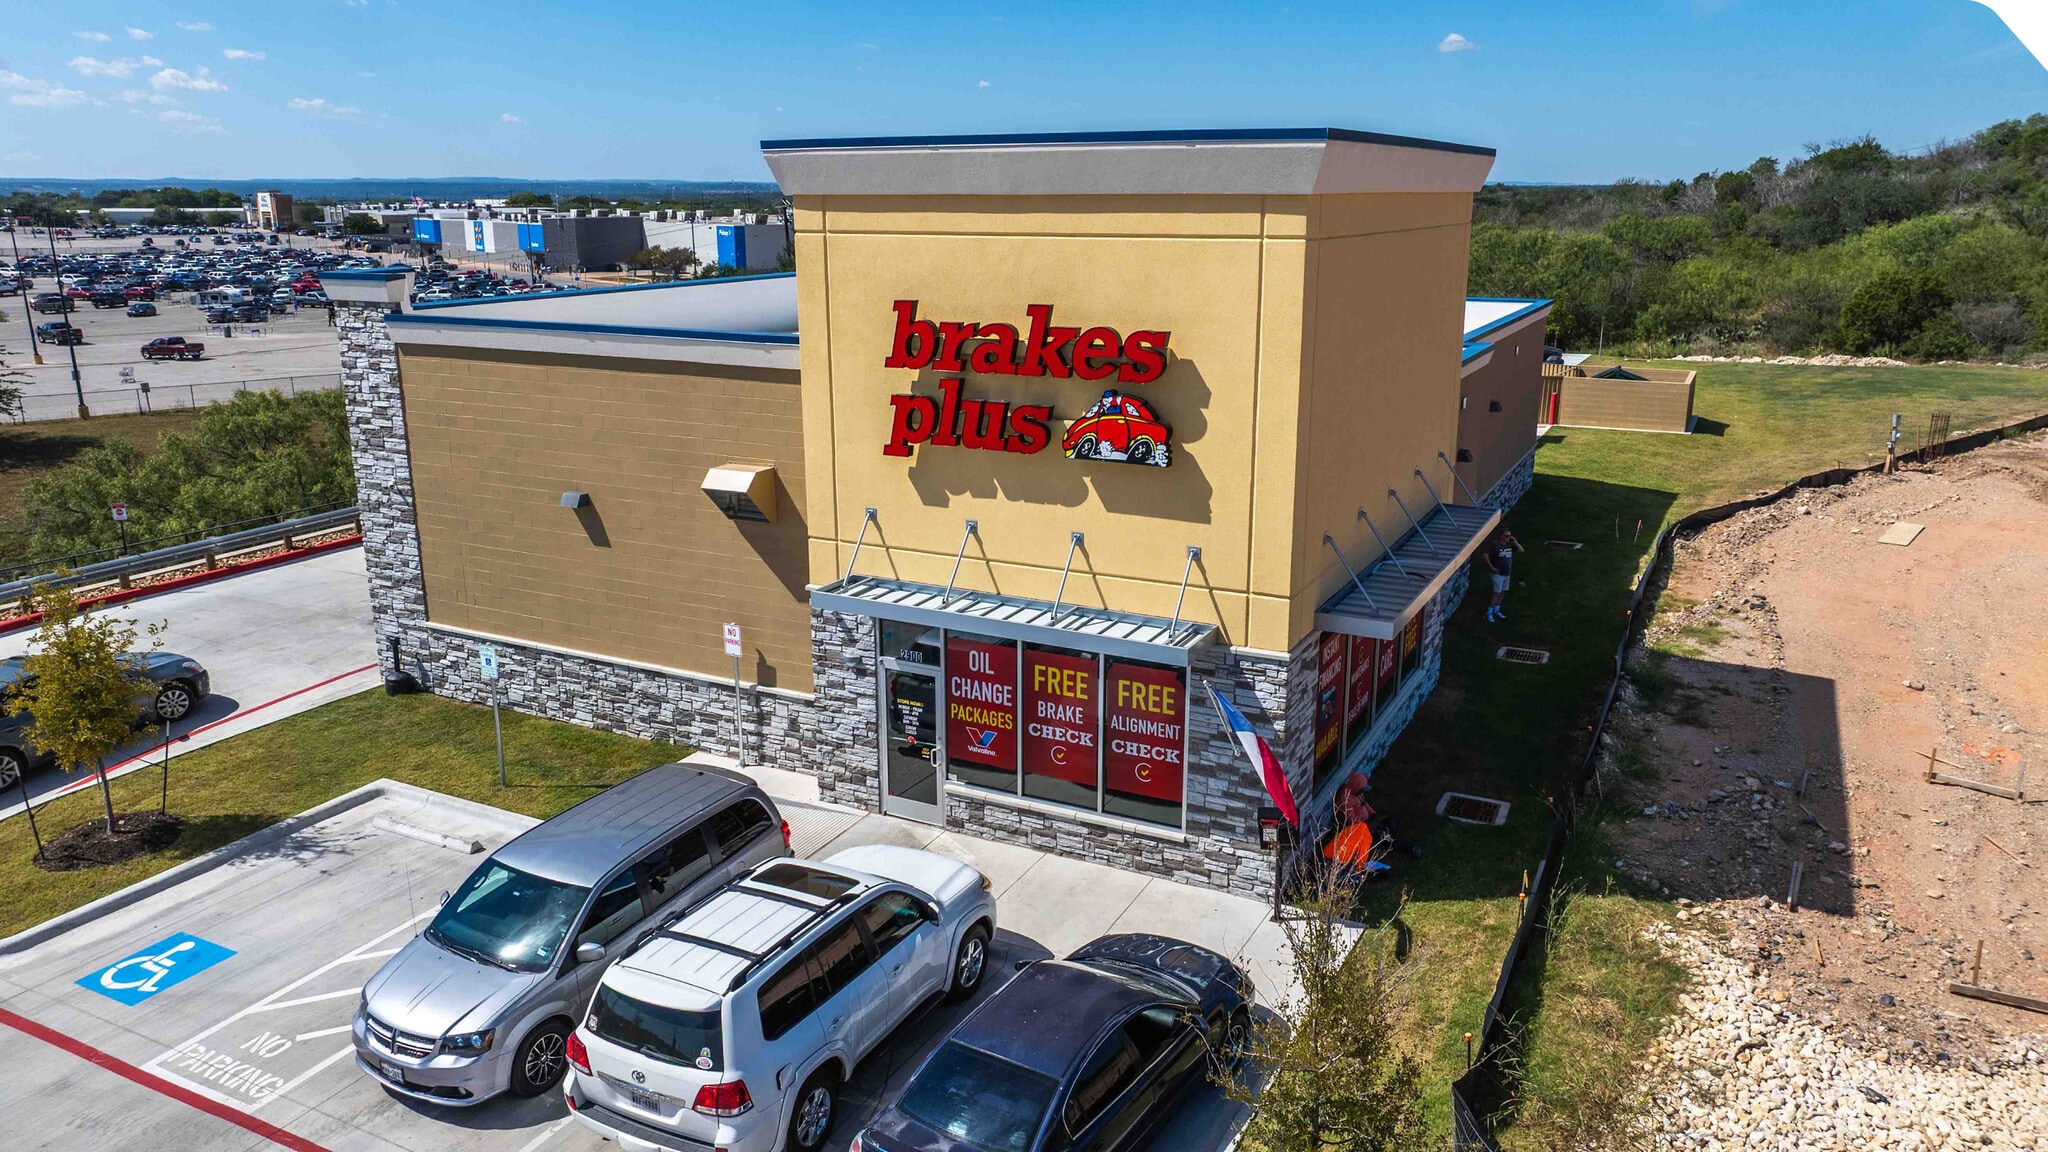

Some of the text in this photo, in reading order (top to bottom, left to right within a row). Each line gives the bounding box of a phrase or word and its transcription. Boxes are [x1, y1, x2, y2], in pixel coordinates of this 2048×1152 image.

[884, 300, 1171, 384] brakes
[883, 377, 1055, 457] plus
[728, 628, 736, 636] NO
[901, 649, 922, 662] 2900
[969, 650, 995, 675] OIL
[951, 676, 1013, 707] CHANGE
[1034, 664, 1089, 700] FREE
[1118, 679, 1176, 716] FREE
[951, 703, 1013, 730] PACKAGES
[1037, 700, 1084, 725] BRAKE
[1028, 723, 1094, 747] CHECK
[1110, 714, 1181, 741] ALIGNMENT
[967, 745, 997, 756] Valvoline
[1111, 739, 1180, 764] CHECK
[240, 1031, 292, 1058] NO
[166, 1043, 284, 1097] PARKING
